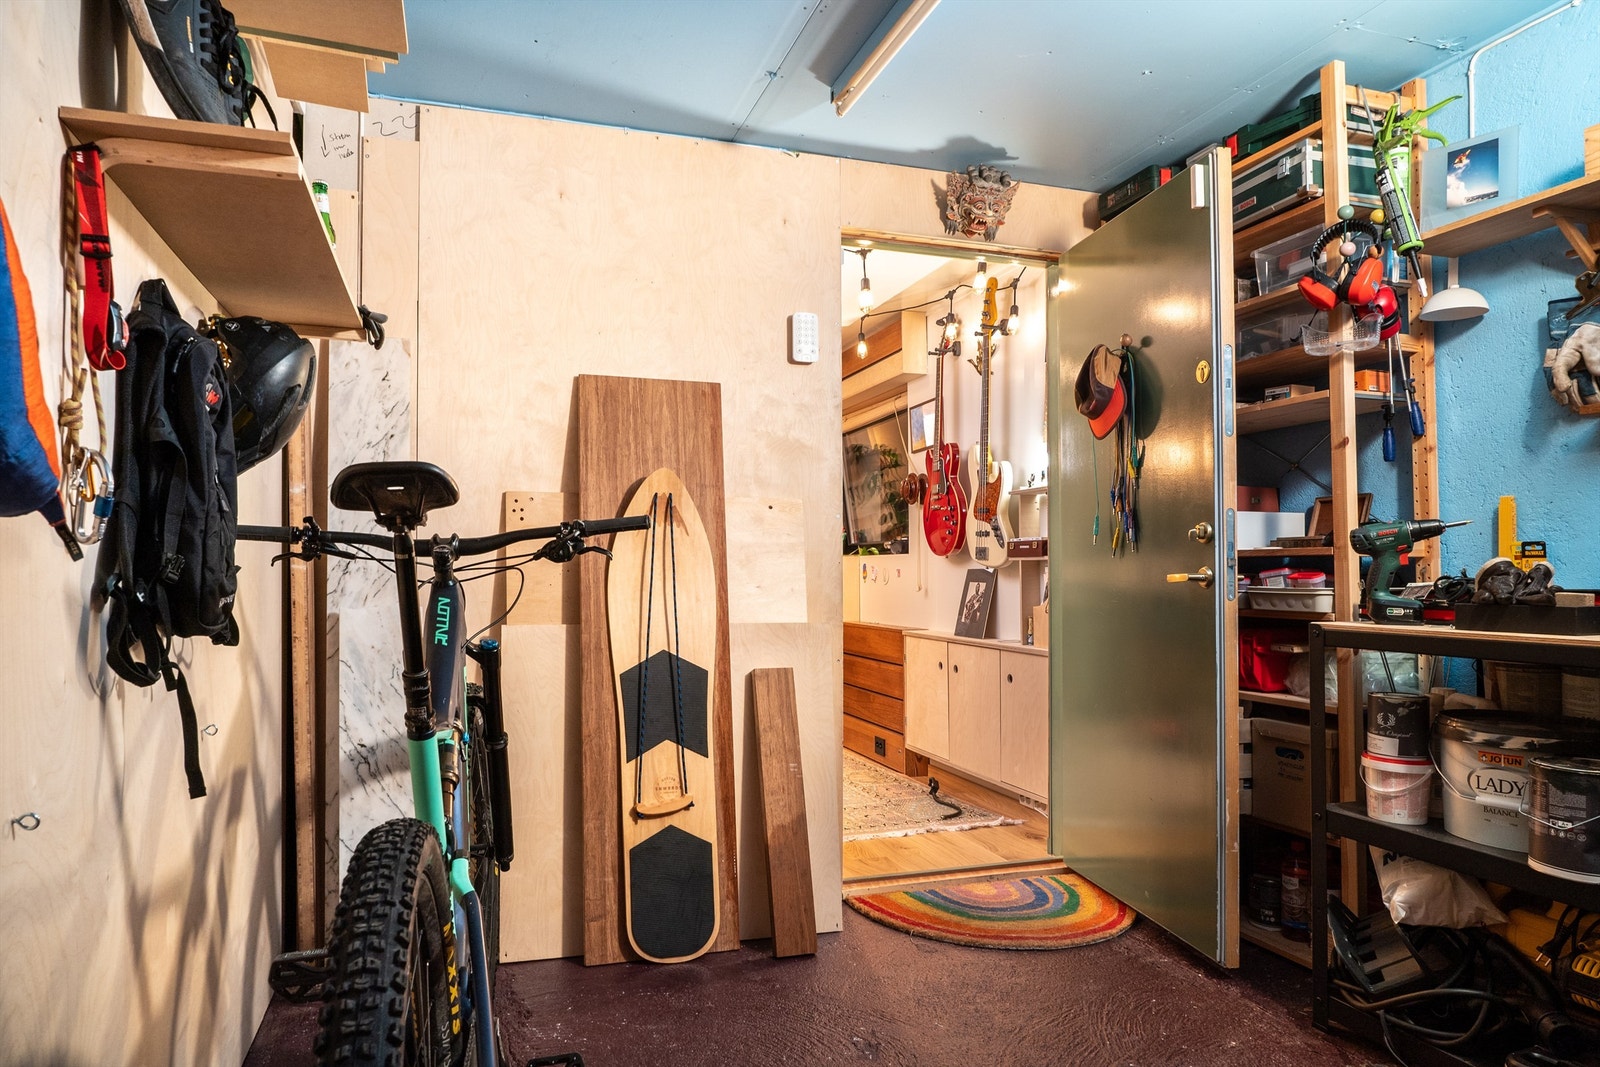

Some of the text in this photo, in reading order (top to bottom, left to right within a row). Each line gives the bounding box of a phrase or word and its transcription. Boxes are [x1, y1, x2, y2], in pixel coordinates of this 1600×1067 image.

[1378, 528, 1398, 537] BOSCH
[434, 597, 451, 646] RALLON
[1490, 754, 1522, 766] JOTUN
[1475, 775, 1526, 796] LADY
[1483, 805, 1520, 819] BALANCE
[443, 921, 462, 1035] MAXXIS
